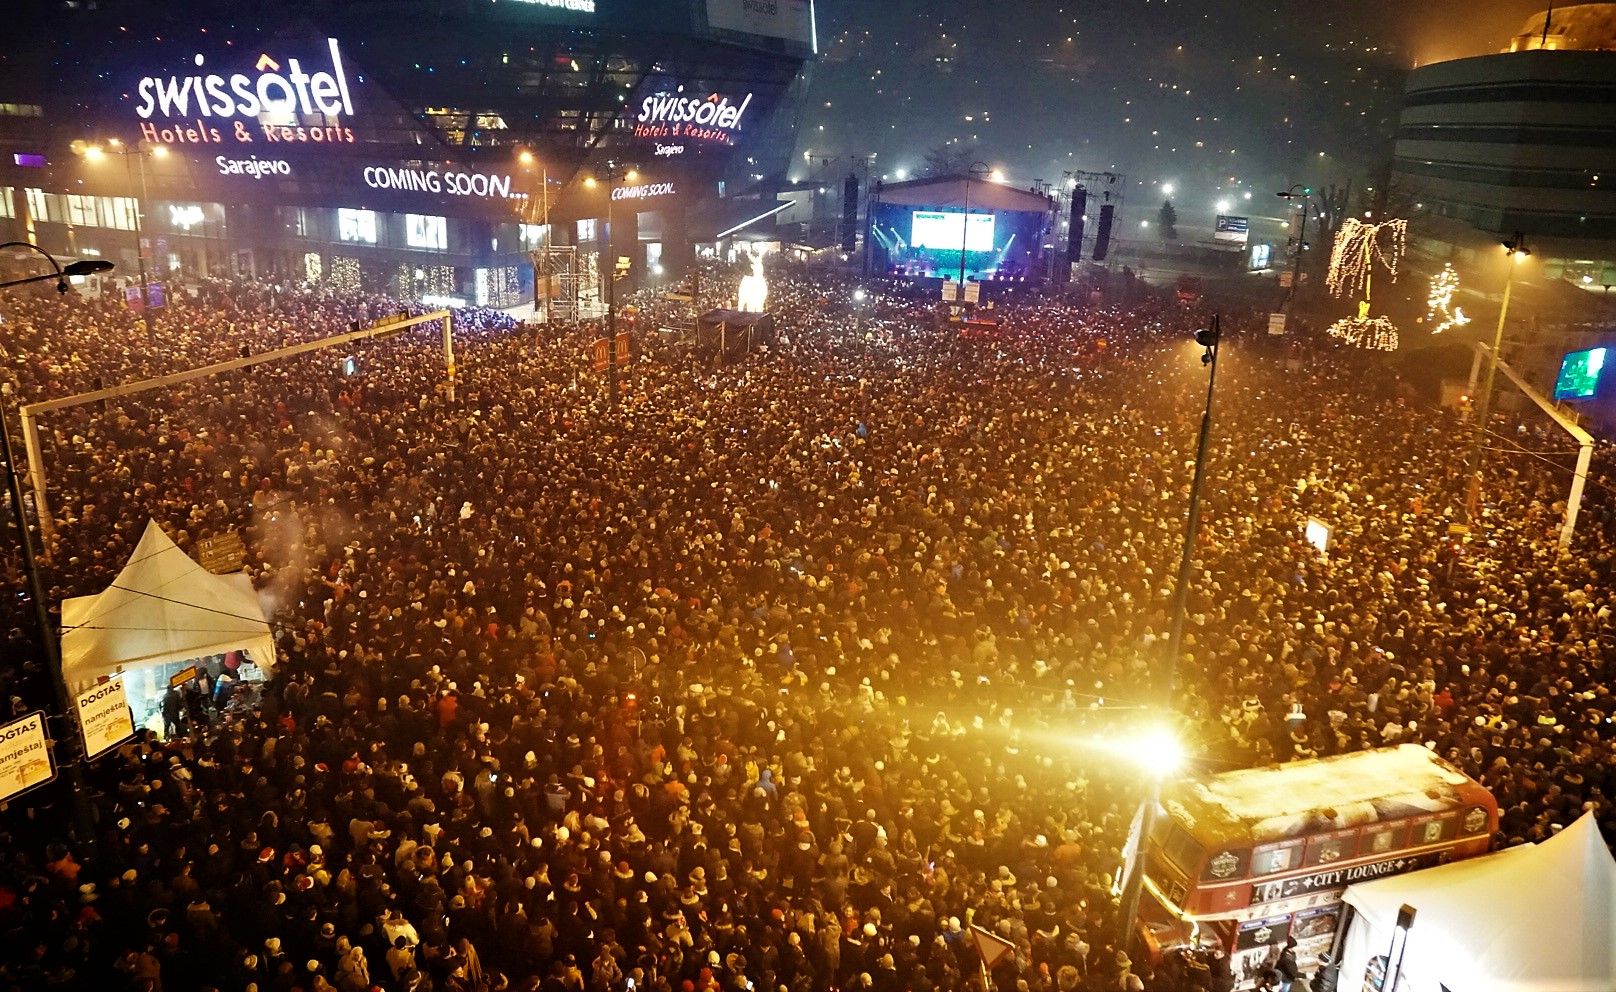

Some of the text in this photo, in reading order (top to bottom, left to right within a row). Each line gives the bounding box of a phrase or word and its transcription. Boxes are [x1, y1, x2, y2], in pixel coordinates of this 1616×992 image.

[136, 38, 354, 118] swissôtel
[638, 84, 752, 129] swissôtel
[140, 119, 355, 143] Hotels & Resorts
[634, 122, 727, 142] Hotels & Resorts
[654, 142, 684, 158] Sarajevo
[215, 154, 291, 179] Sarajevo
[363, 166, 529, 200] COMING SOON...
[611, 184, 648, 201] COMING
[80, 681, 121, 708] DOGTAS
[0, 720, 37, 744] OGTAS
[0, 739, 43, 764] amještaj
[1313, 859, 1396, 888] CITY LOUNGE
